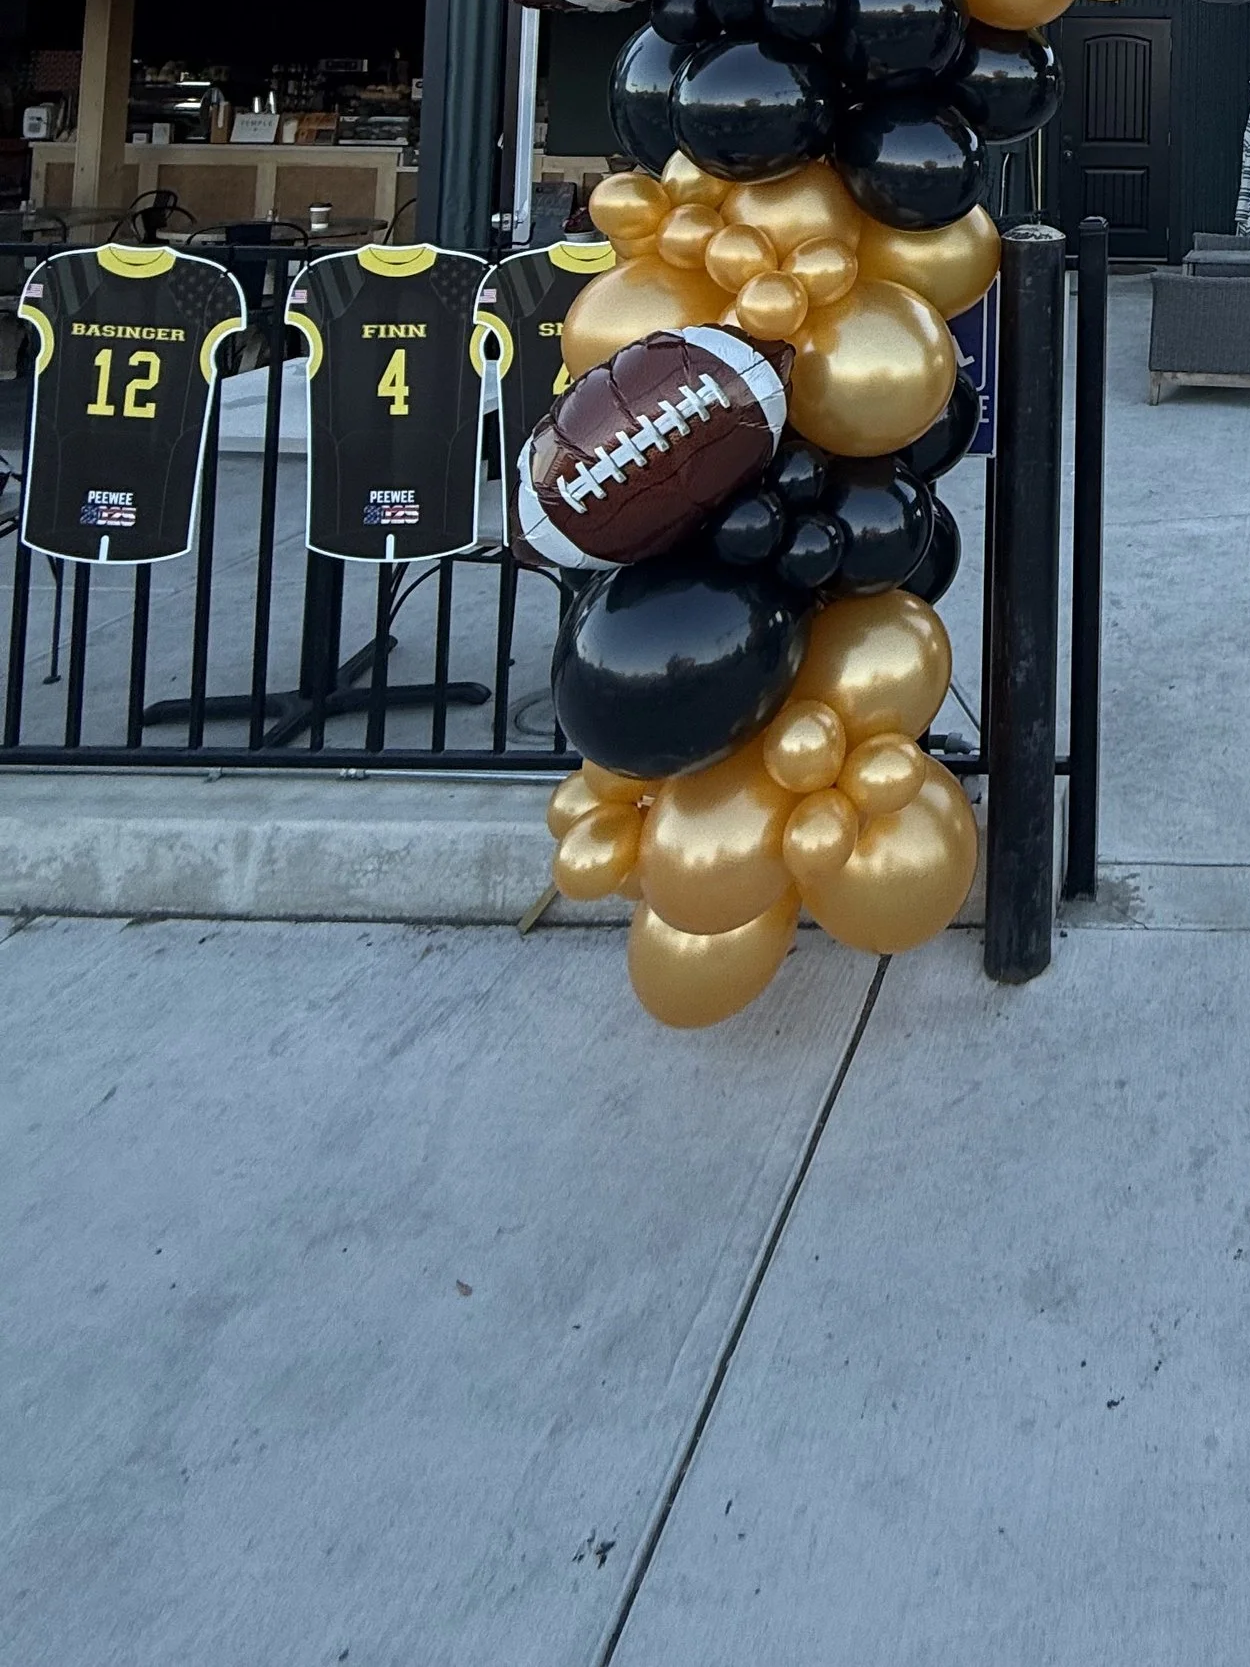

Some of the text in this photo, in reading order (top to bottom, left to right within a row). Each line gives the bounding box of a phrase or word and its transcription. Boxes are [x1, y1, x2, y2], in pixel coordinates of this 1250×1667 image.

[71, 322, 186, 342] BASINGER
[362, 324, 427, 339] FINN
[87, 348, 160, 419] 12
[377, 348, 410, 415] 4
[87, 490, 134, 506] PEEWEE
[369, 490, 415, 504] PEEWEE
